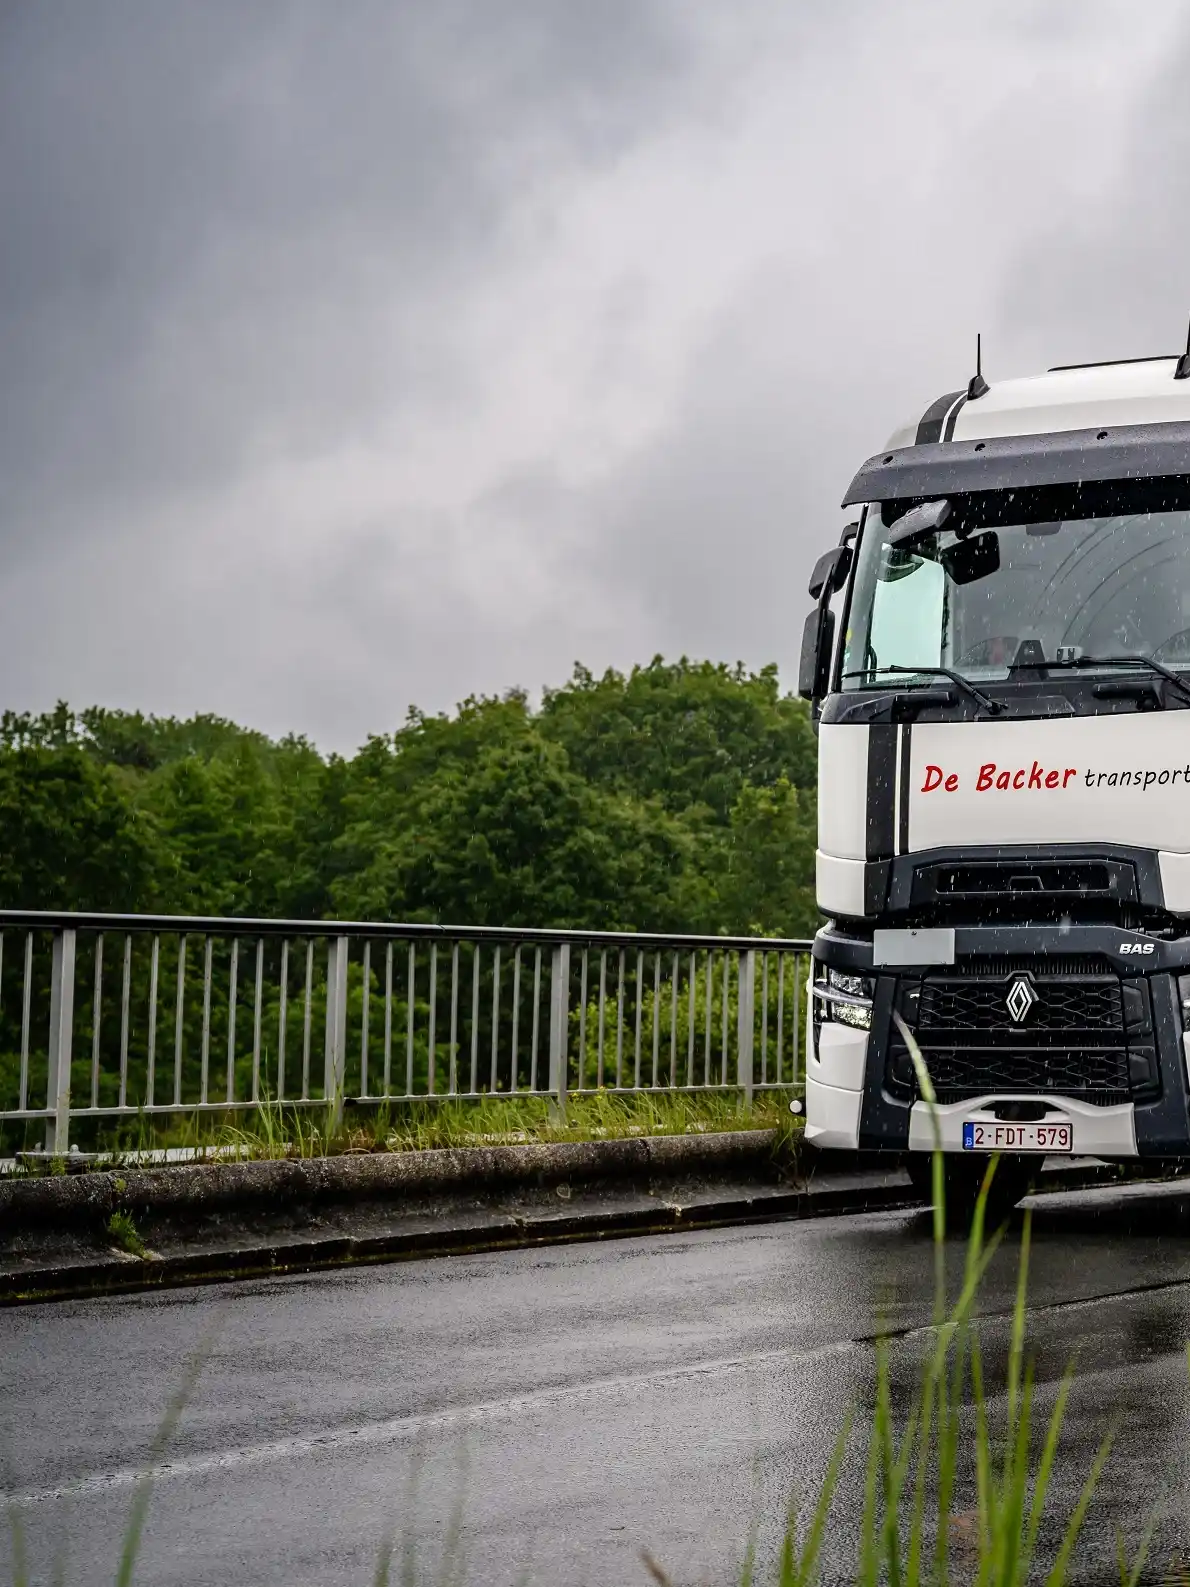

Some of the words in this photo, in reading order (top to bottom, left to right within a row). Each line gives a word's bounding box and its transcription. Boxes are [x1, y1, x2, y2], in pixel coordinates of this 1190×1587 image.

[921, 765, 959, 793] De
[975, 761, 1078, 791] Backer
[1119, 943, 1155, 955] BAS
[965, 1137, 973, 1146] B
[975, 1127, 1068, 1146] 2-FDT-579
